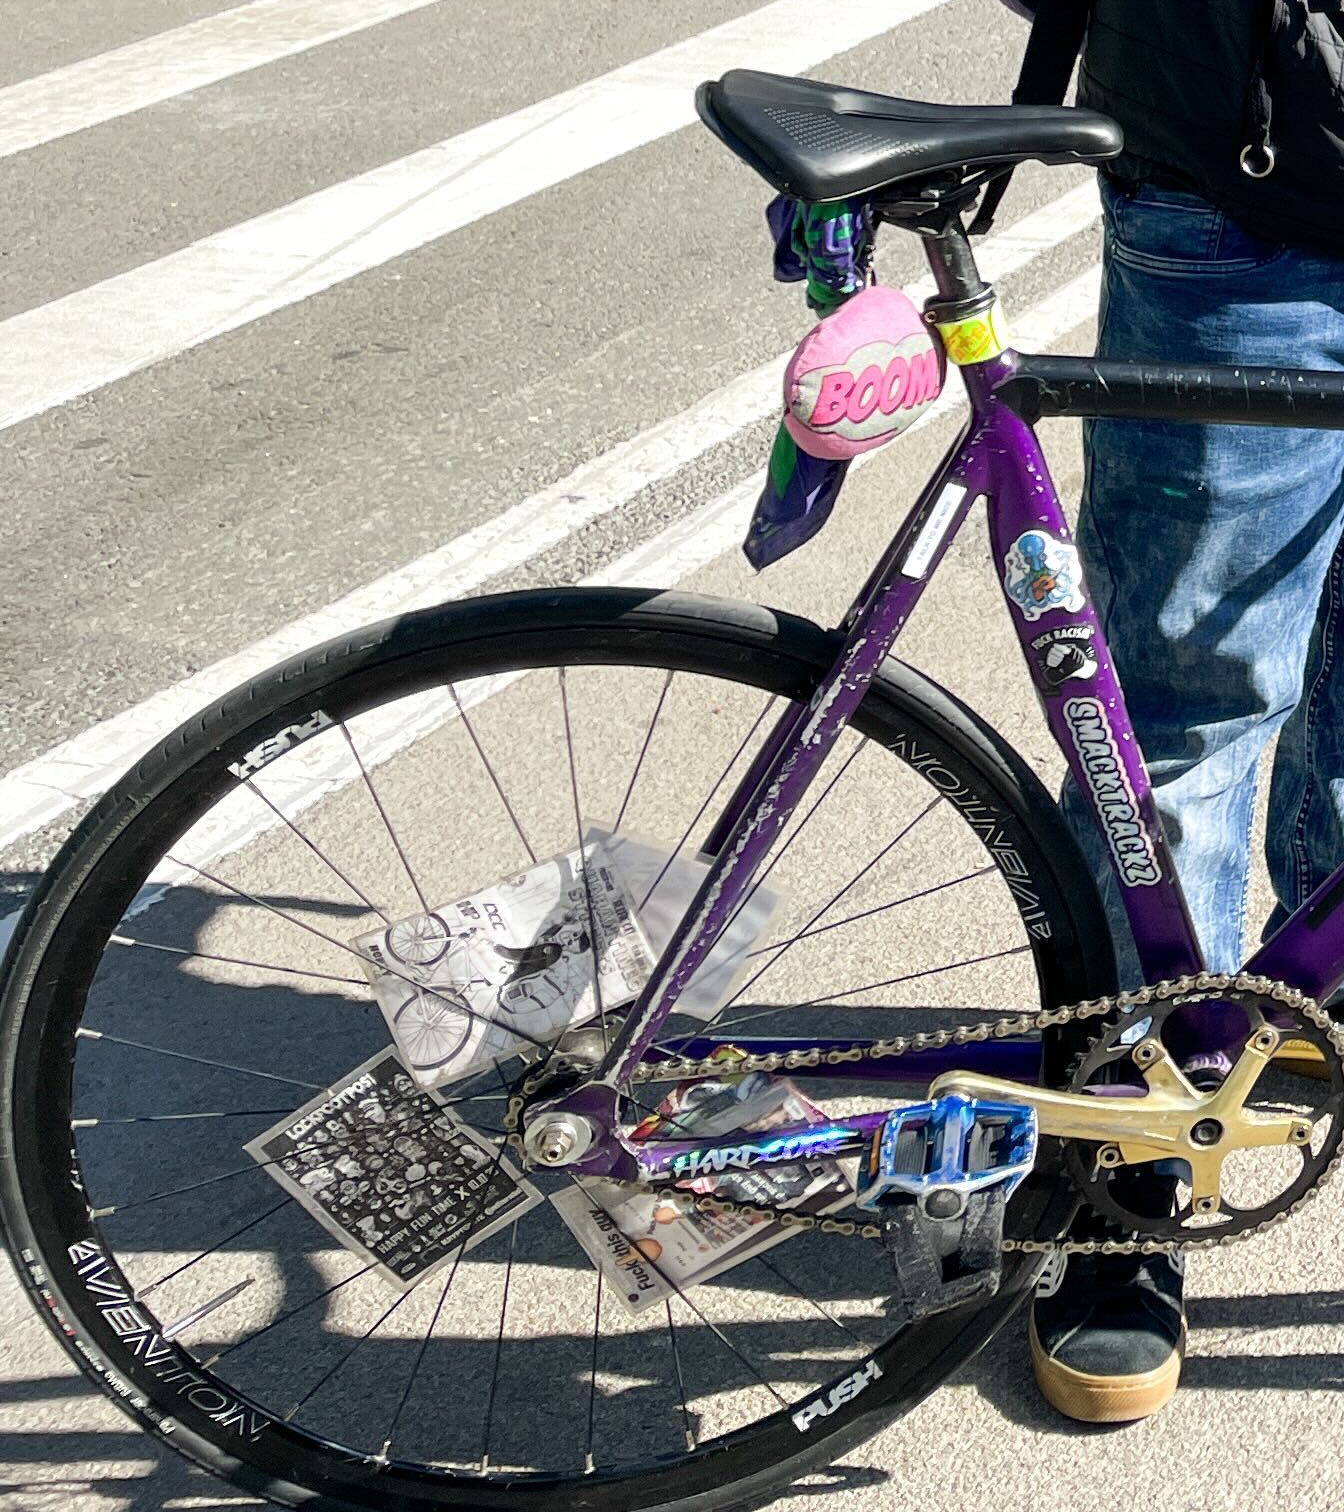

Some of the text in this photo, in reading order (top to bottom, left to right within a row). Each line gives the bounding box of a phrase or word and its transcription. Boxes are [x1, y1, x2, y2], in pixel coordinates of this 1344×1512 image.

[1064, 699, 1159, 885] SMACKTRACKZ
[376, 1227, 410, 1255] HAPPY
[409, 1211, 432, 1233] FUN
[430, 1194, 457, 1217] TIME
[604, 1230, 632, 1261] this
[623, 1254, 656, 1294] Fuck
[792, 1358, 886, 1432] PUSH
